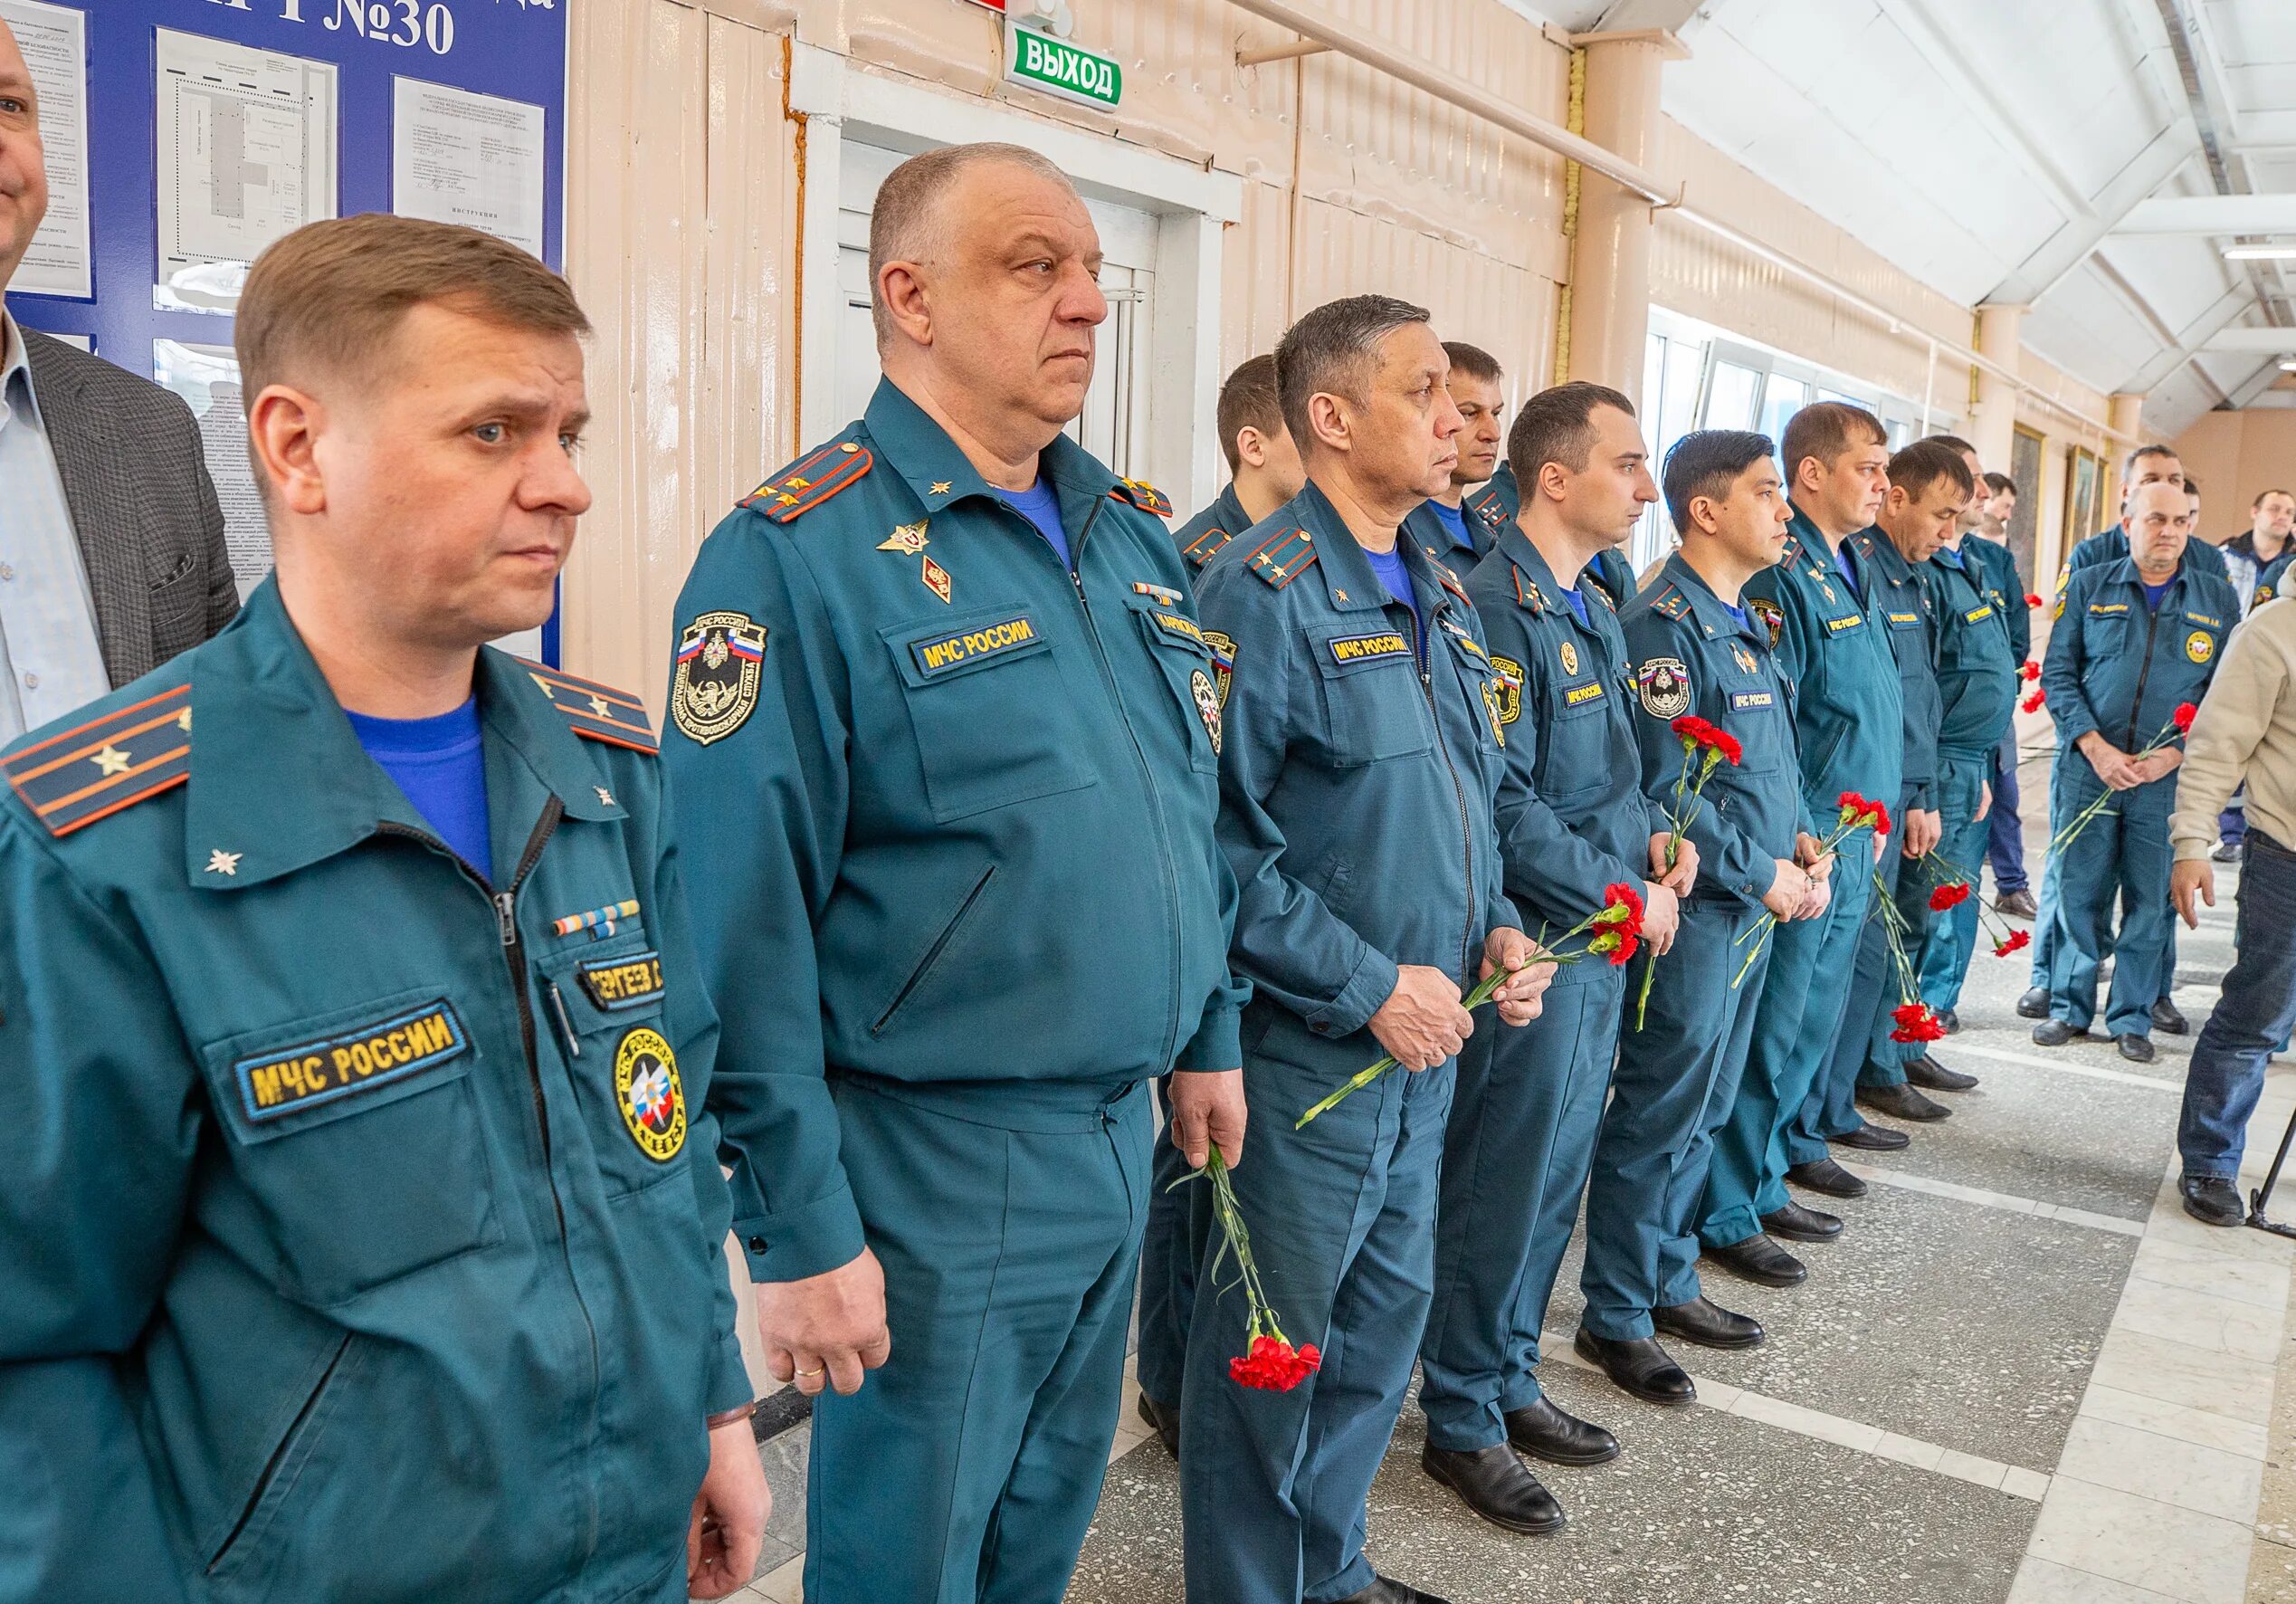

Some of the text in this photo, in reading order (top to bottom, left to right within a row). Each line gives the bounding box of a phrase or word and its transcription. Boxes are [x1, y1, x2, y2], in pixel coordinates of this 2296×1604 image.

[1025, 37, 1114, 99] ВЫХОД
[714, 616, 746, 628] РОССИИ
[922, 619, 1034, 669] МЧС РОССИИ
[1204, 635, 1226, 645] РОССИИ
[1333, 635, 1407, 660] МЧС РОССИИ
[743, 662, 757, 698] СЛУЖБА
[1491, 659, 1517, 673] РОССИИ
[251, 1013, 454, 1108] МЧС РОССИИ
